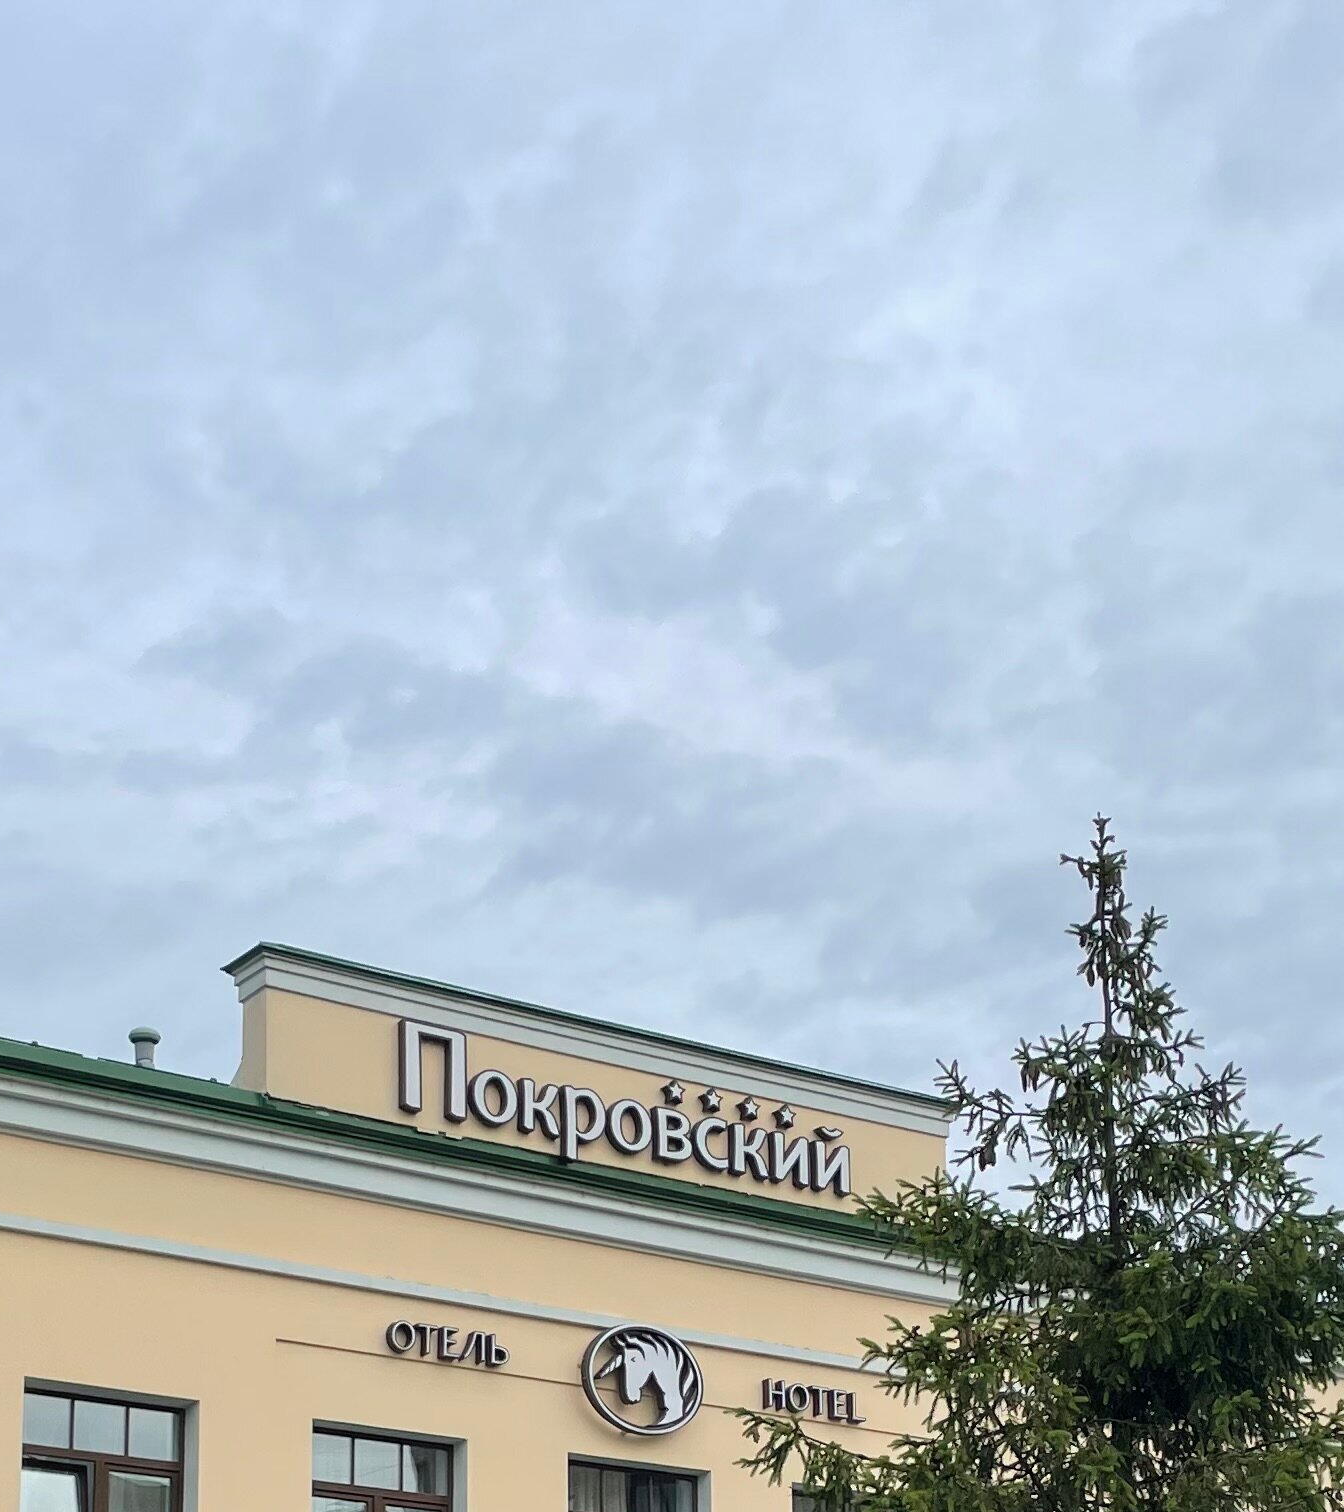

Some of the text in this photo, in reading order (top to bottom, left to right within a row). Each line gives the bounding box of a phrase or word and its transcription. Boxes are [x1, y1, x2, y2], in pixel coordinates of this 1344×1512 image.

[398, 1018, 852, 1197] Покровский
[386, 1320, 511, 1367] ОТЕЛЬ
[762, 1378, 867, 1425] HOTEL
